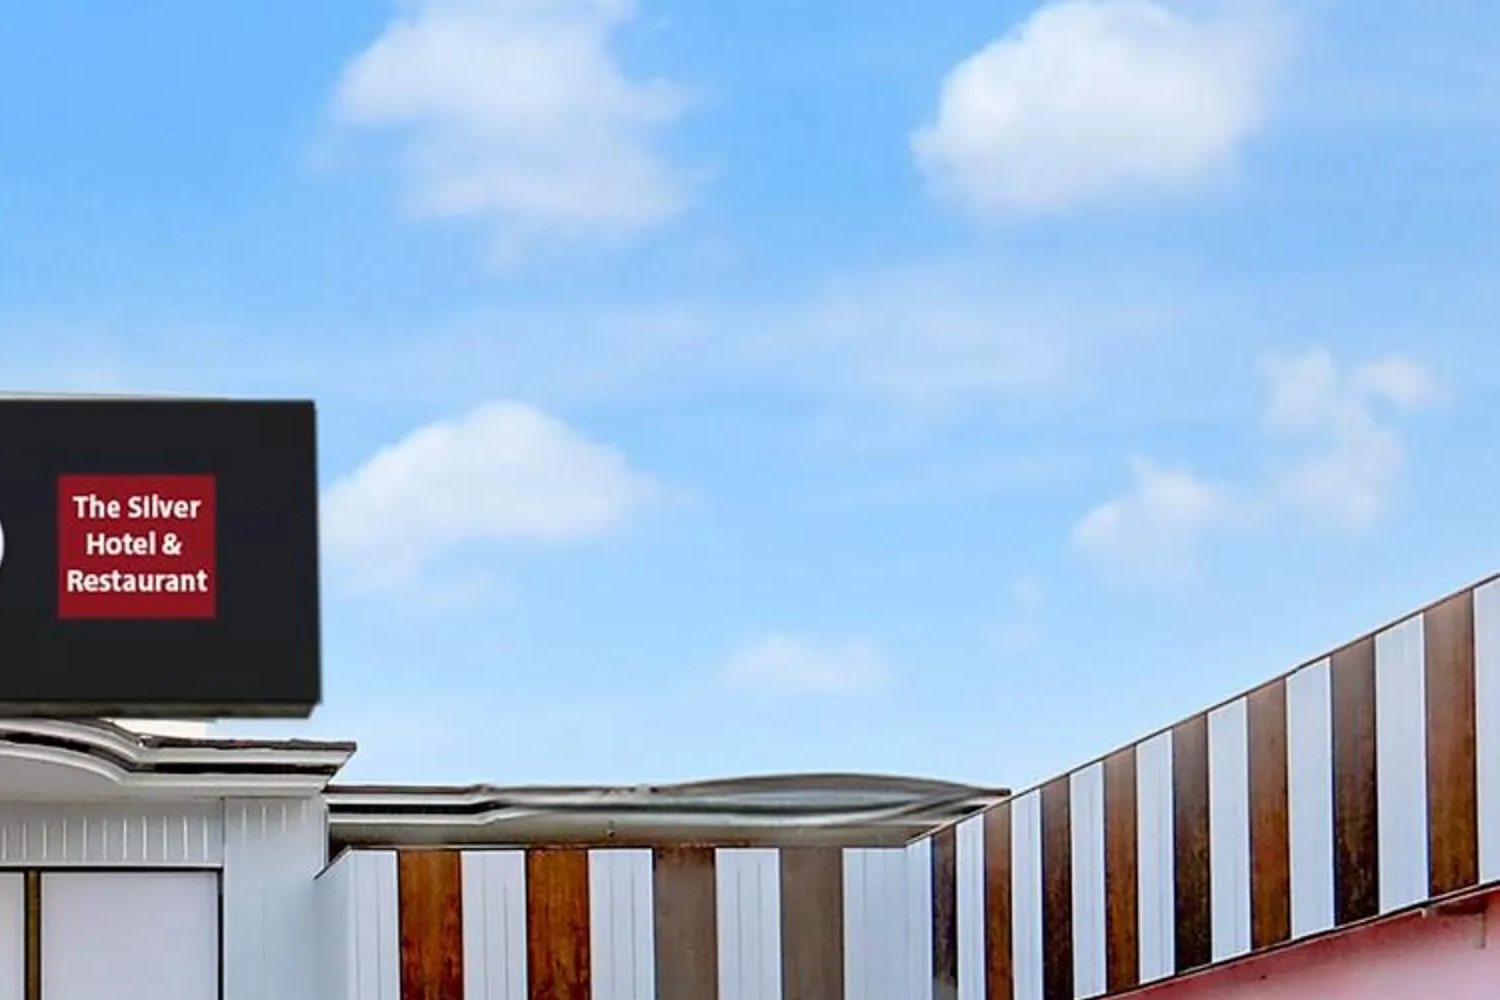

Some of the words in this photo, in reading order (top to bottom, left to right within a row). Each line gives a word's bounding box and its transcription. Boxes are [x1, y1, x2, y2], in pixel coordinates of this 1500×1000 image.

[72, 493, 121, 519] The
[127, 493, 202, 519] Silver
[86, 530, 157, 556] Hotel
[161, 532, 182, 556] &
[66, 569, 209, 593] Restaurant
